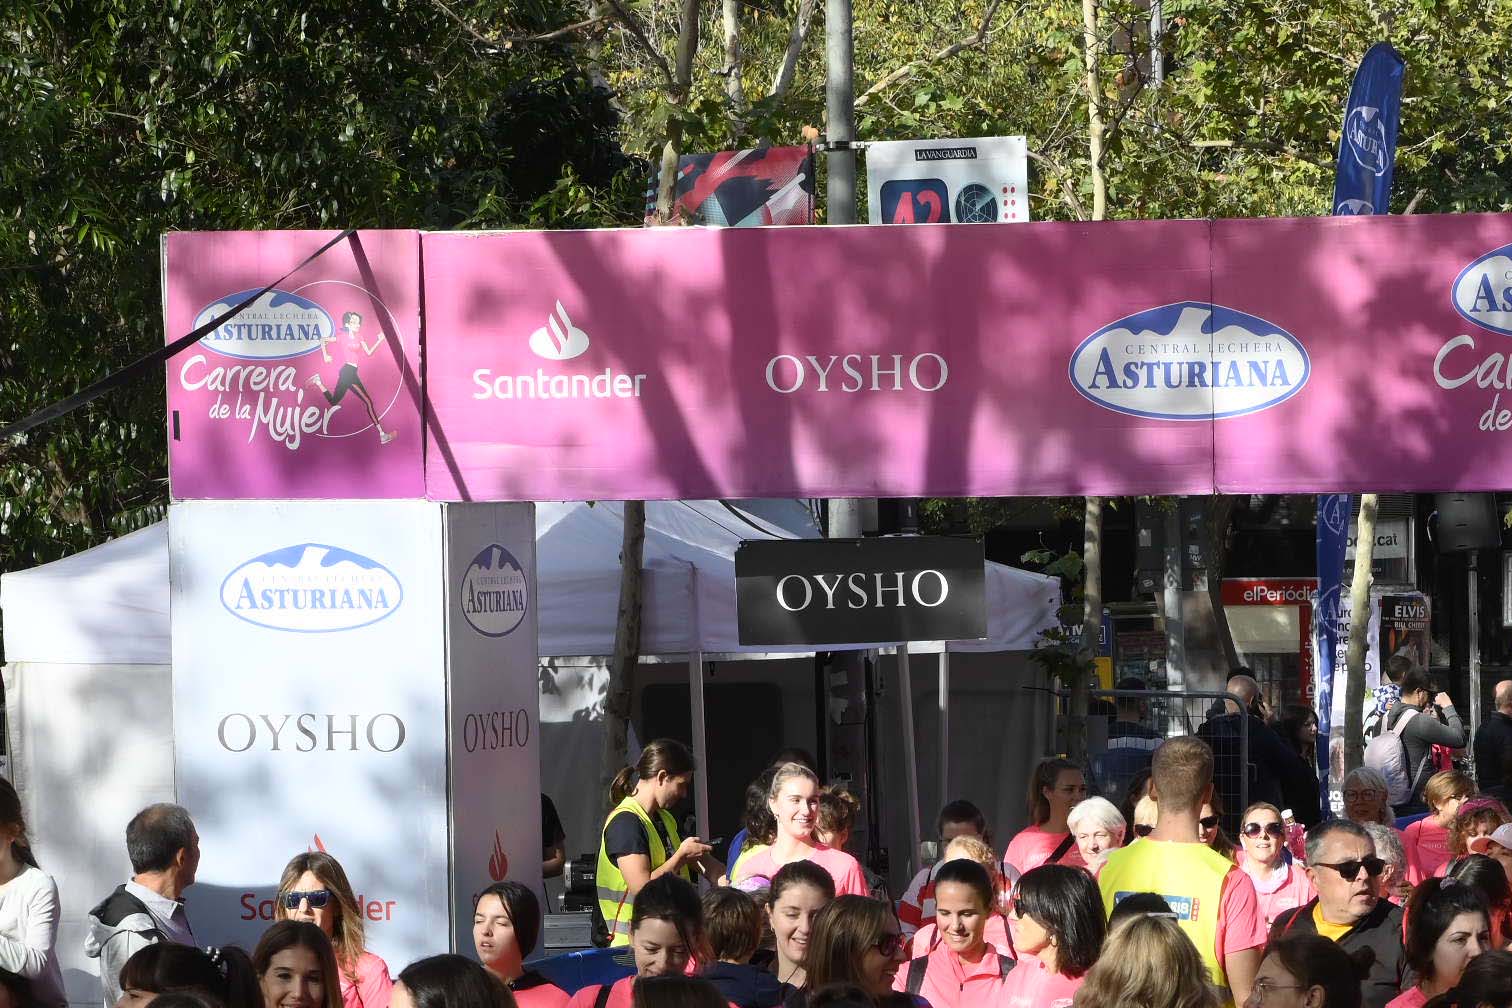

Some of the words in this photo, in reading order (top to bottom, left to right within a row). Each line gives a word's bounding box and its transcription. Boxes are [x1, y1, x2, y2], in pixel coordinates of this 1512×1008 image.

[927, 149, 976, 160] VANGUARDIA
[203, 313, 322, 341] ASTURIANA
[1124, 344, 1199, 356] CENTRAL
[1207, 342, 1285, 356] LECHERA
[179, 355, 298, 392] Carrera
[472, 368, 647, 400] Santander
[764, 352, 950, 394] OYSHO
[1087, 346, 1293, 390] ASTURIANA
[208, 399, 232, 421] de
[235, 400, 252, 421] la
[248, 392, 342, 451] Mujer
[234, 576, 390, 611] ASTURIANA
[466, 580, 525, 614] ASTURIANA
[775, 569, 950, 612] OYSHO
[1243, 585, 1320, 603] elPeriódi
[1394, 605, 1425, 618] ELVIS
[217, 712, 407, 753] OYSHO
[463, 708, 530, 753] OYSHO
[239, 891, 396, 922] Sader
